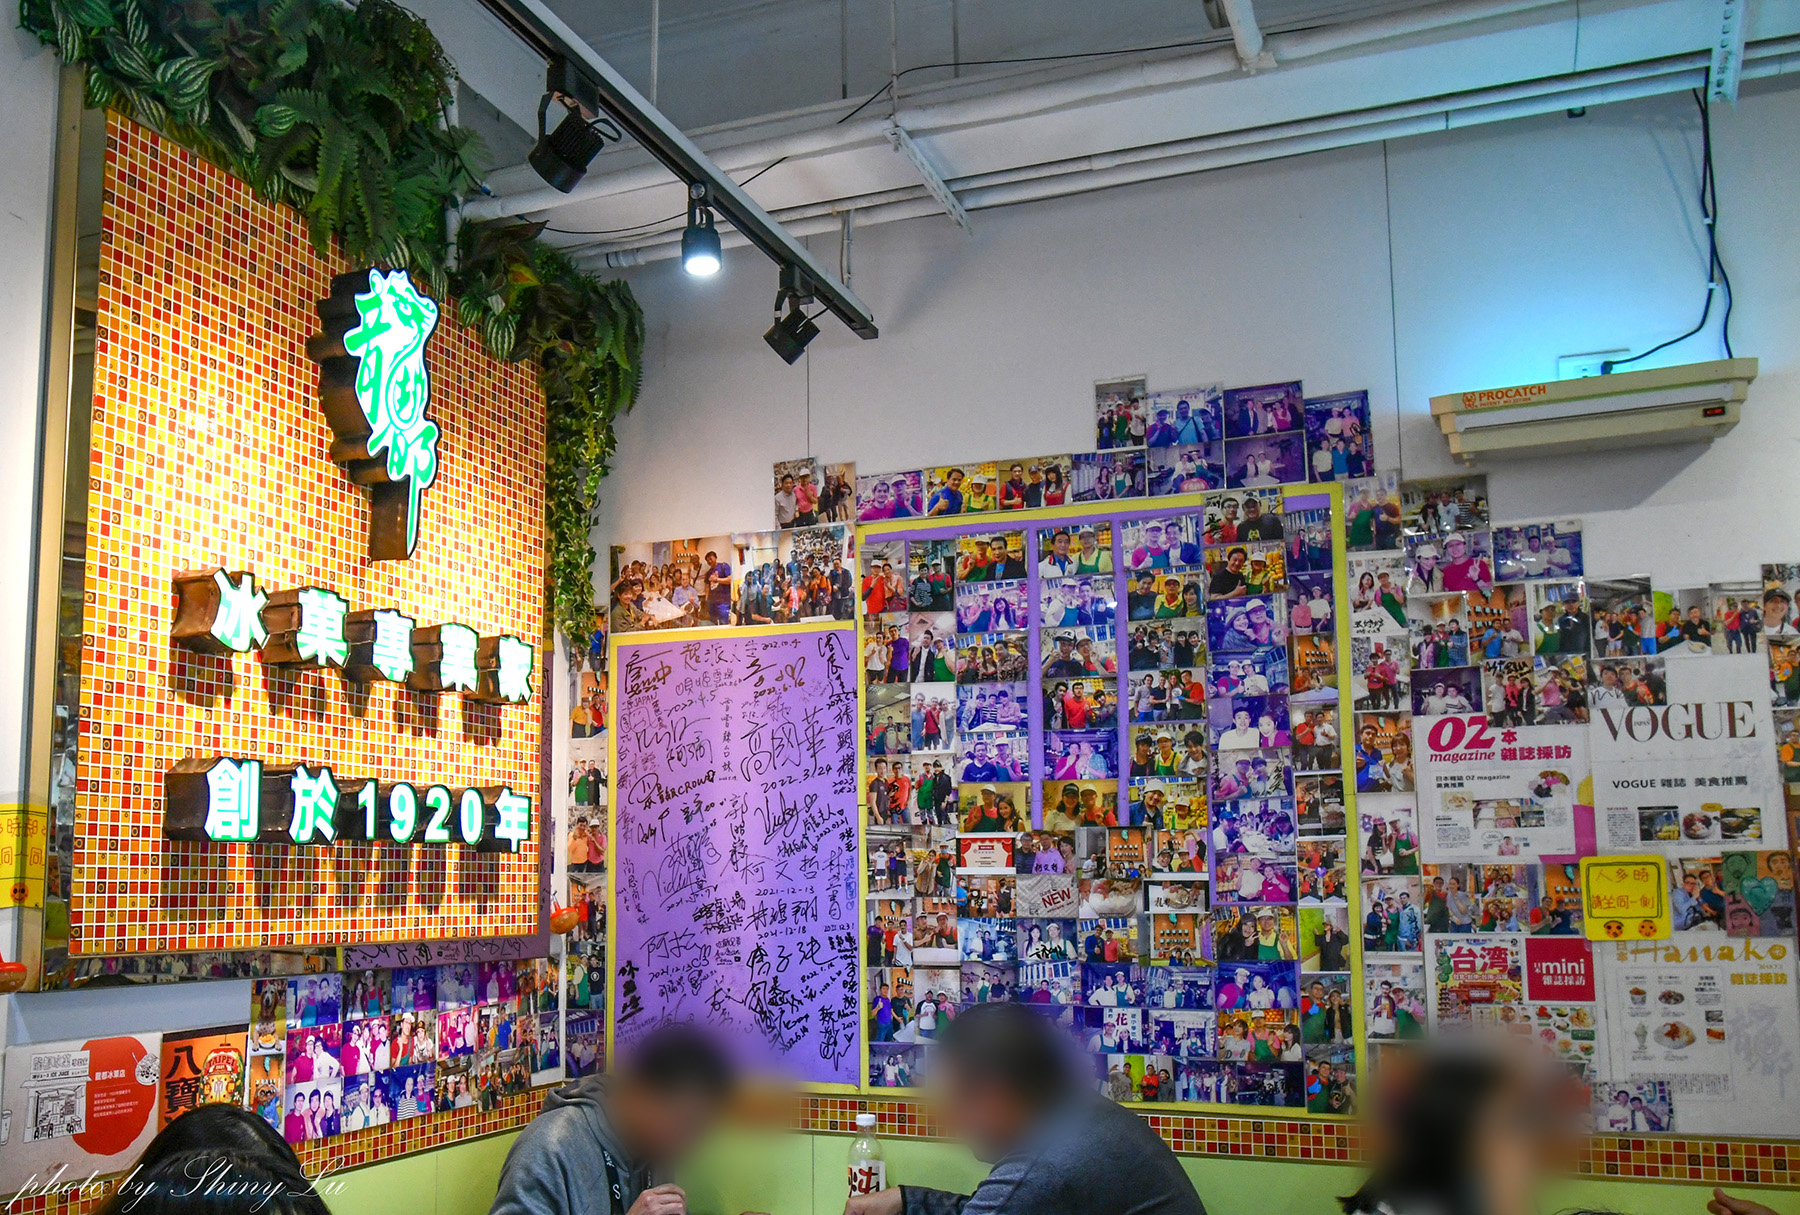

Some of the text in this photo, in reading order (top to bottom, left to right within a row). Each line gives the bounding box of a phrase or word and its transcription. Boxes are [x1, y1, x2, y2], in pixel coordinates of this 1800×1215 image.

[1478, 385, 1546, 402] PROCATCH
[211, 568, 534, 704] 冰菓專業家
[1599, 700, 1756, 743] VOGUE
[1427, 715, 1496, 752] OZ
[1429, 750, 1496, 764] magazine
[1500, 745, 1572, 761] 雜誌採訪
[1477, 774, 1511, 782] magazine
[1612, 779, 1656, 789] VOGUE
[1660, 778, 1687, 788] 雜誌
[204, 757, 532, 853] 創於1920年
[740, 854, 820, 885] 柯文哲
[1595, 867, 1649, 883] 人多時
[755, 885, 815, 896] 2021-12-13
[1041, 887, 1072, 909] NEW
[1629, 938, 1788, 963] Hanako
[1450, 946, 1509, 973] 台湾
[1542, 958, 1585, 974] mini
[207, 1055, 236, 1067] TAIPEI
